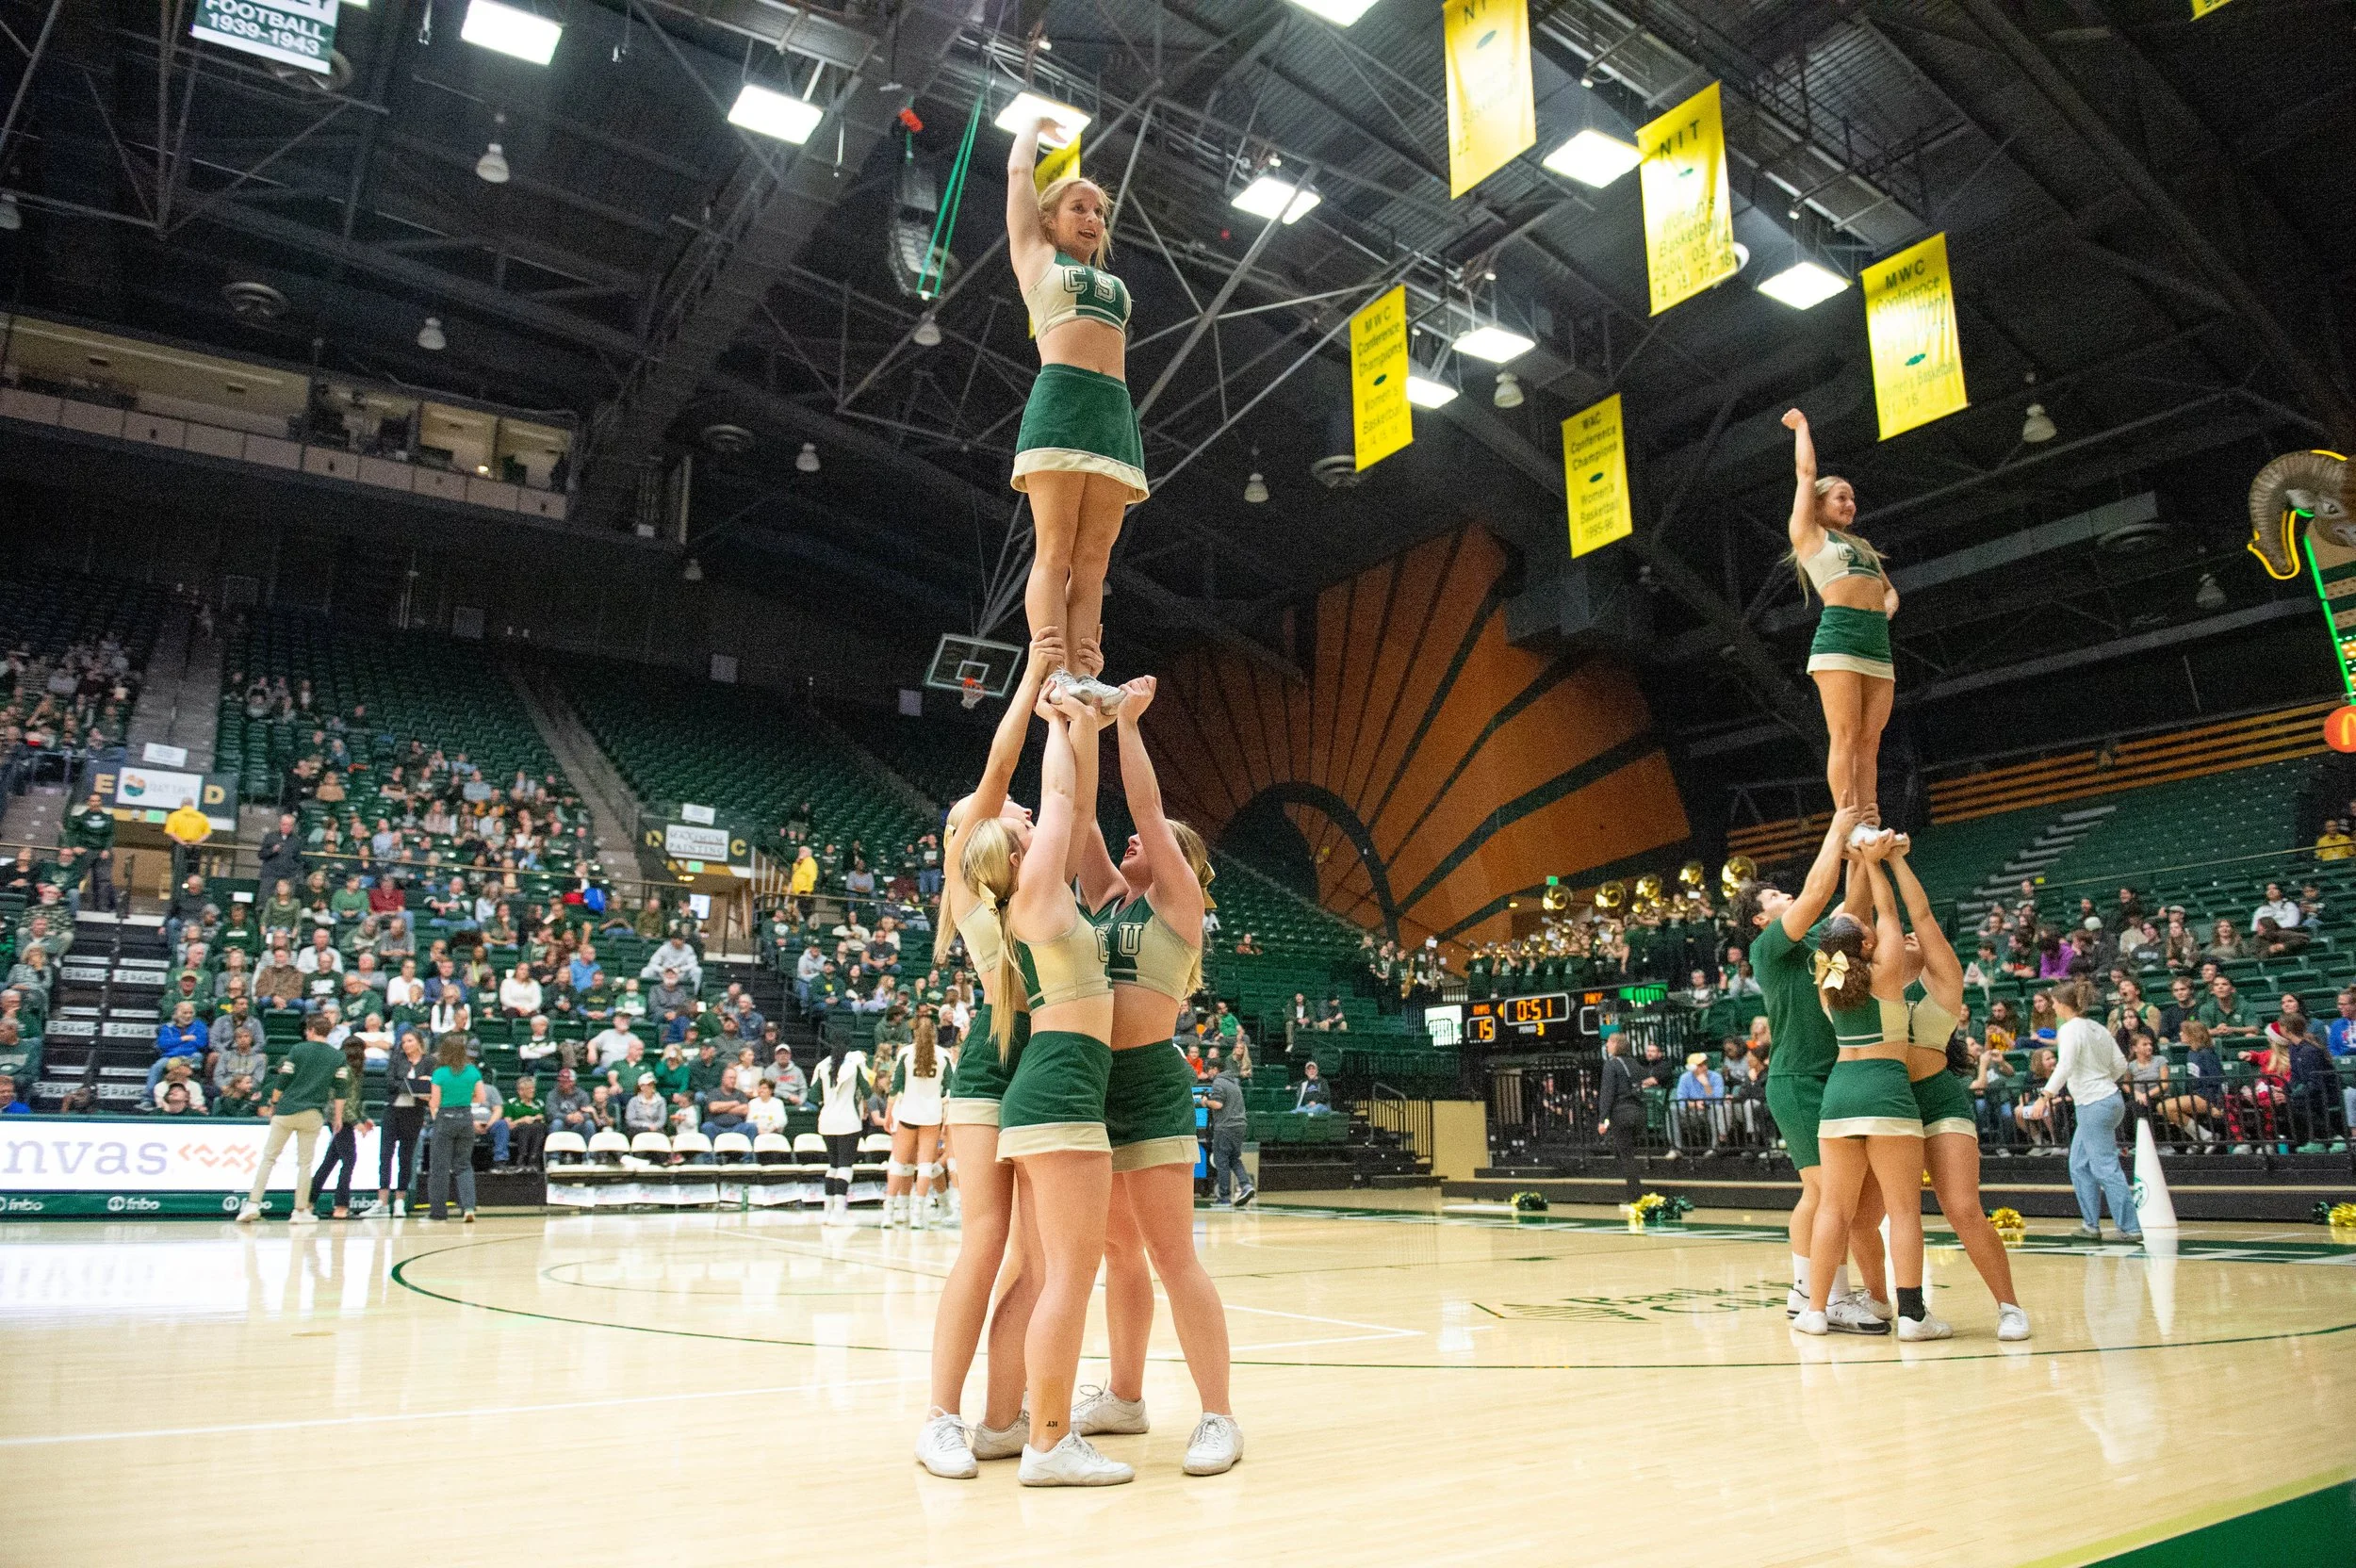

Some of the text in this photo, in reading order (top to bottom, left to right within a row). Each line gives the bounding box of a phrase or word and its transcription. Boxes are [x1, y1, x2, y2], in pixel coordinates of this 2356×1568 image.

[208, 11, 320, 56] 1939-1943
[1659, 119, 1700, 159] NIT
[1885, 259, 1926, 290] MWC
[1365, 305, 1392, 334] MWC
[1573, 440, 1618, 471] Champions
[95, 773, 115, 794] E
[204, 784, 225, 805] D
[669, 830, 724, 843] MAXIMUM
[669, 841, 726, 855] PAINTING
[730, 839, 746, 857] C
[1118, 922, 1145, 956] U
[130, 972, 159, 983] RAMS
[1516, 998, 1552, 1022] 0:51
[61, 1025, 92, 1035] RAMS
[121, 1026, 153, 1036] RAMS
[1478, 1018, 1494, 1041] 15
[1537, 1021, 1546, 1037] 3
[126, 1197, 161, 1211] fnbo
[1562, 1286, 1727, 1306] Bank
